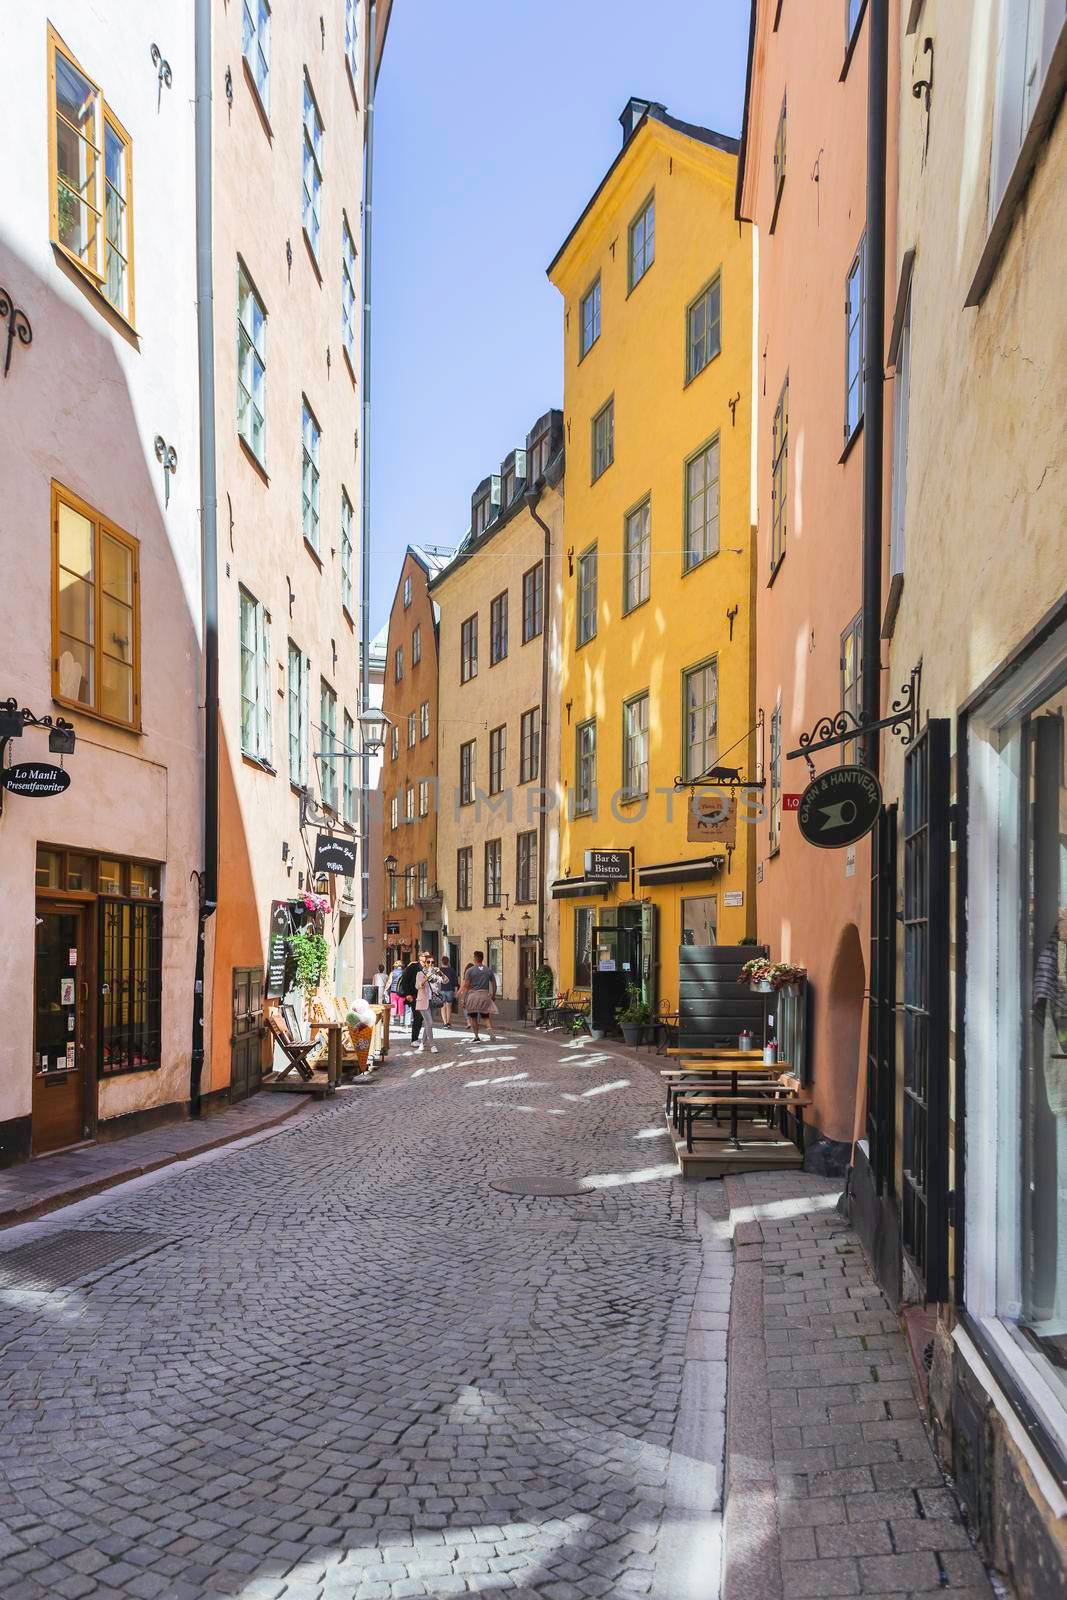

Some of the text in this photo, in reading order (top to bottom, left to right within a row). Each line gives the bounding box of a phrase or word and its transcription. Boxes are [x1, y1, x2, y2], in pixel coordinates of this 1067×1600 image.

[15, 769, 58, 780] Lo Manli
[7, 781, 64, 793] Presentfavoriter
[801, 771, 878, 824] GARN & HANTVERK
[595, 854, 620, 862] Bar &
[595, 864, 620, 872] Bistro
